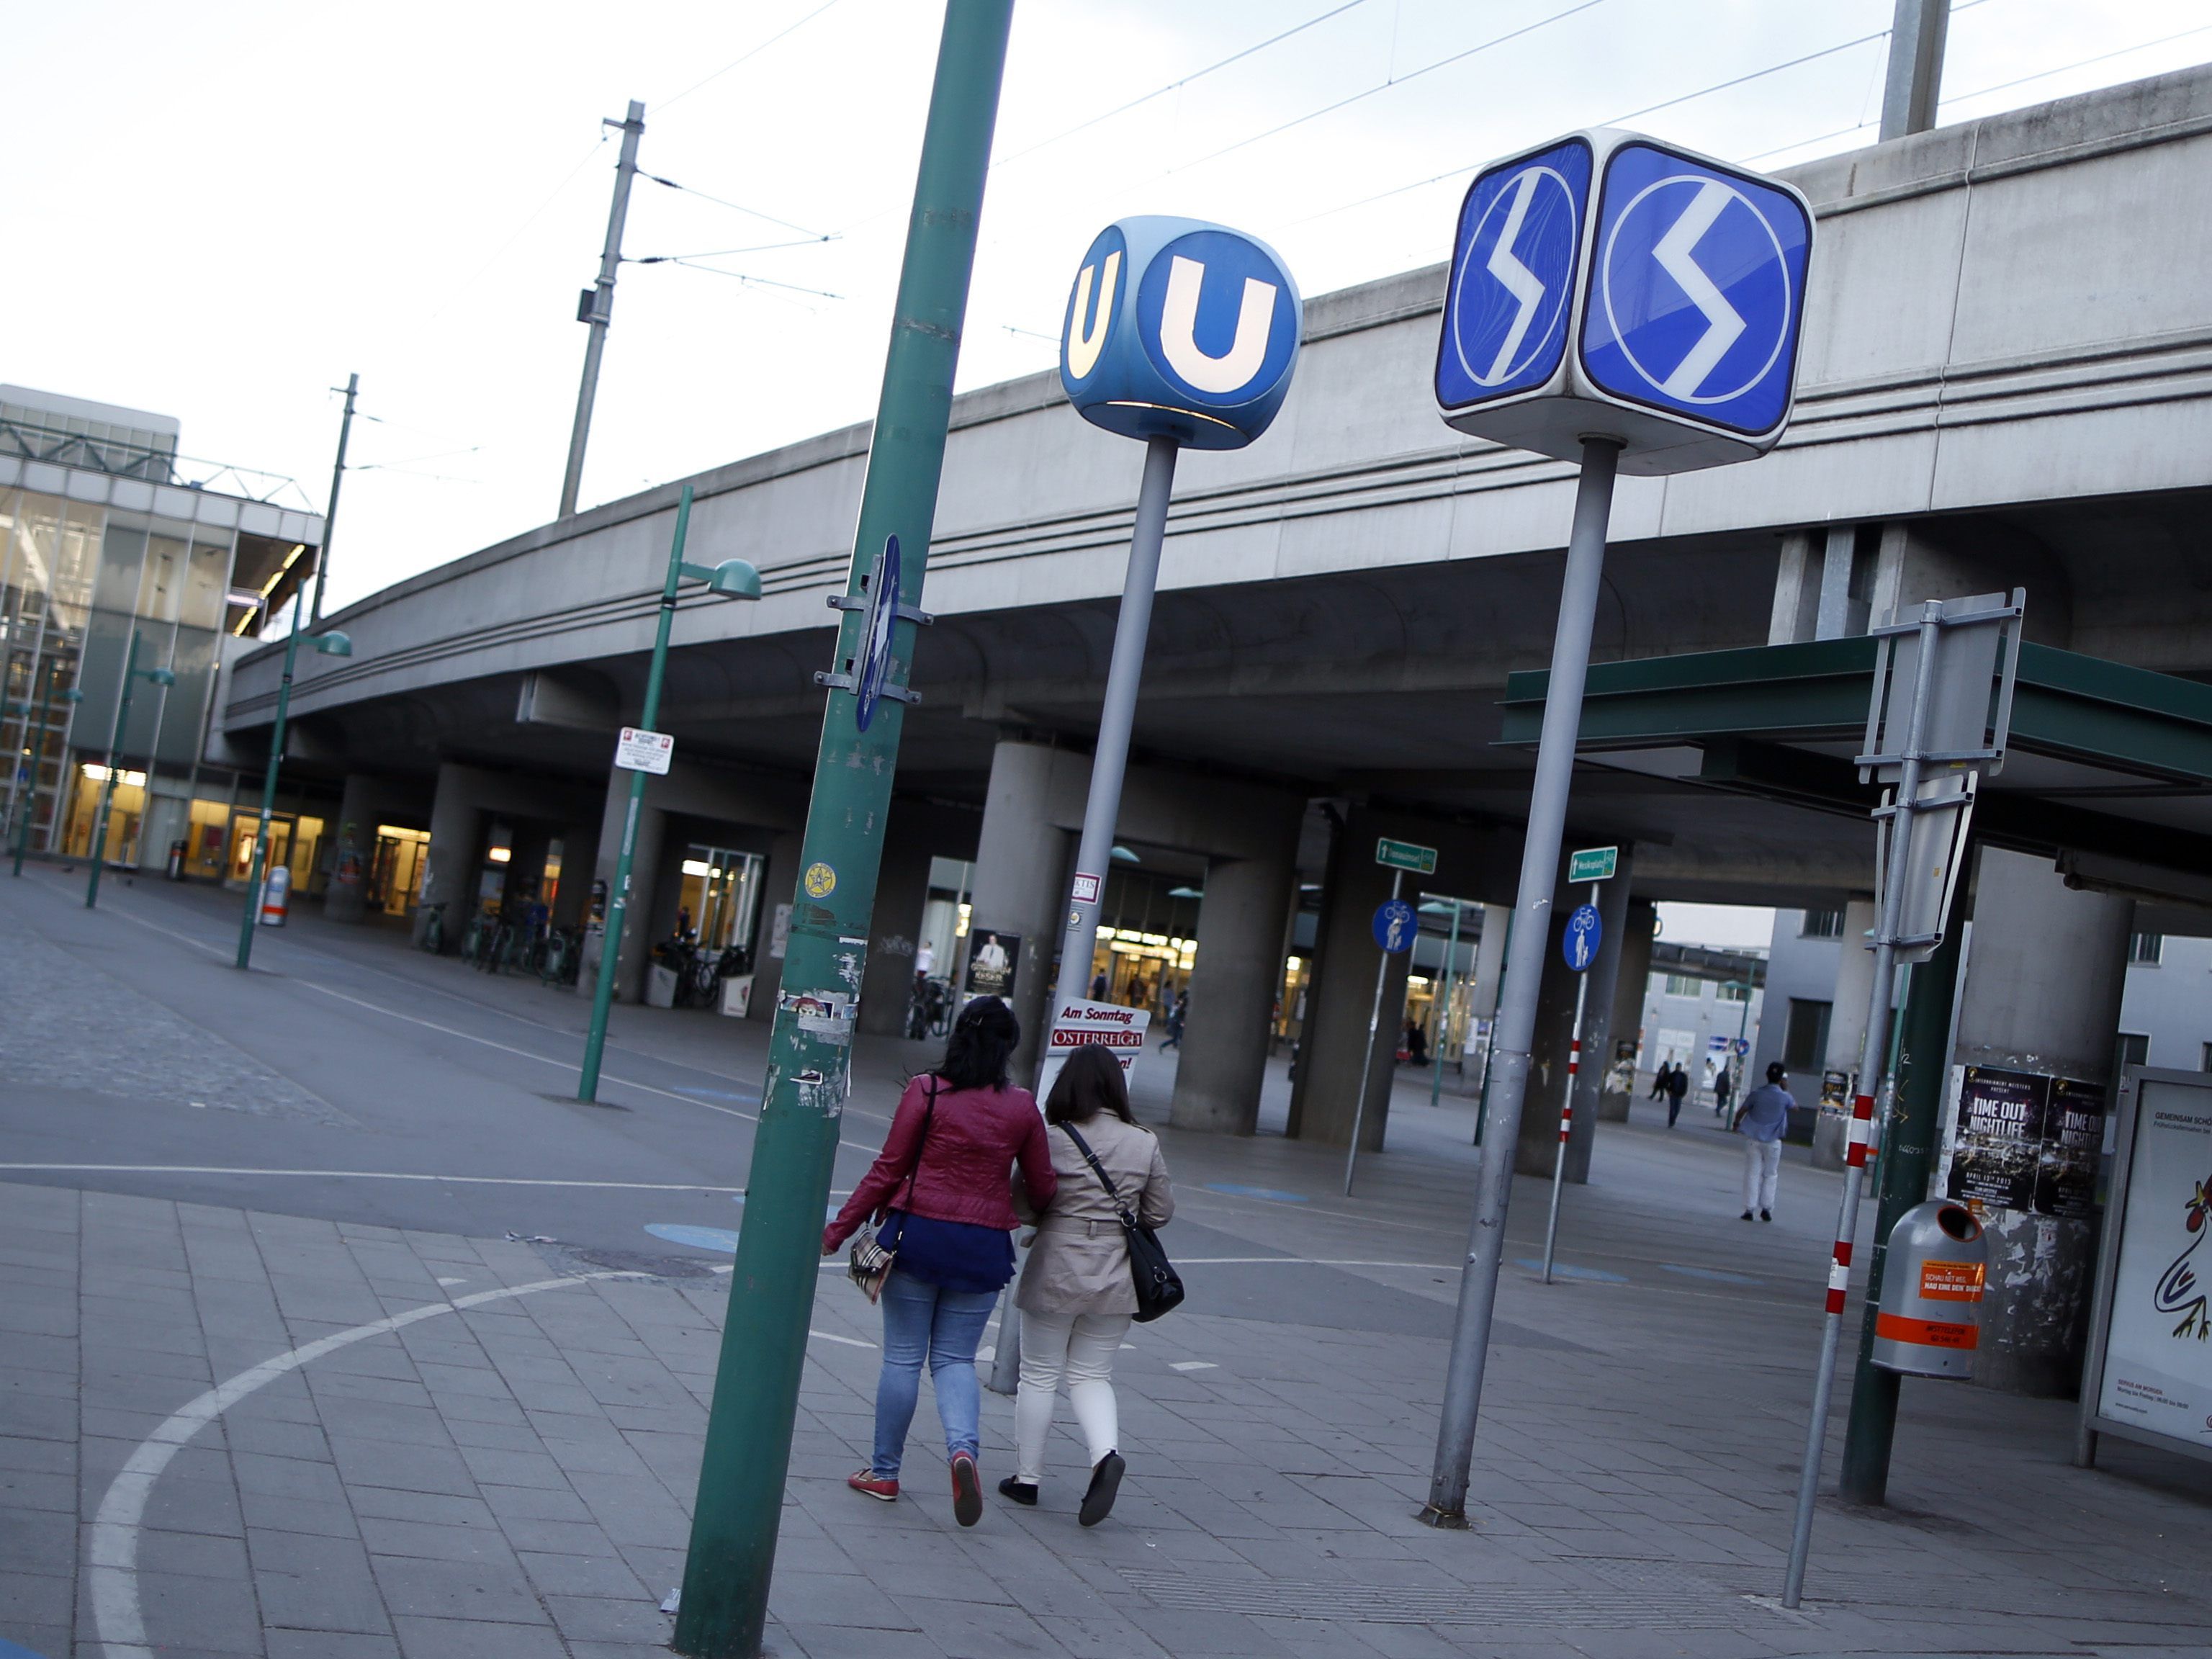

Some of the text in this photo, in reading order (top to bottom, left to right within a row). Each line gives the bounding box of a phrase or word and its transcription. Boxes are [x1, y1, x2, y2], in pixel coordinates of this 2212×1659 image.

[1067, 250, 1121, 379] U
[1159, 255, 1277, 394] U
[1061, 1006, 1135, 1025] Am Sonntag
[1053, 1029, 1141, 1045] ÖSTERREICH
[1973, 1096, 2027, 1122] TIME OUT
[1969, 1115, 2028, 1138] NIGHTLIFE
[2065, 1110, 2089, 1131] TIME
[1924, 1282, 1938, 1290] HAU
